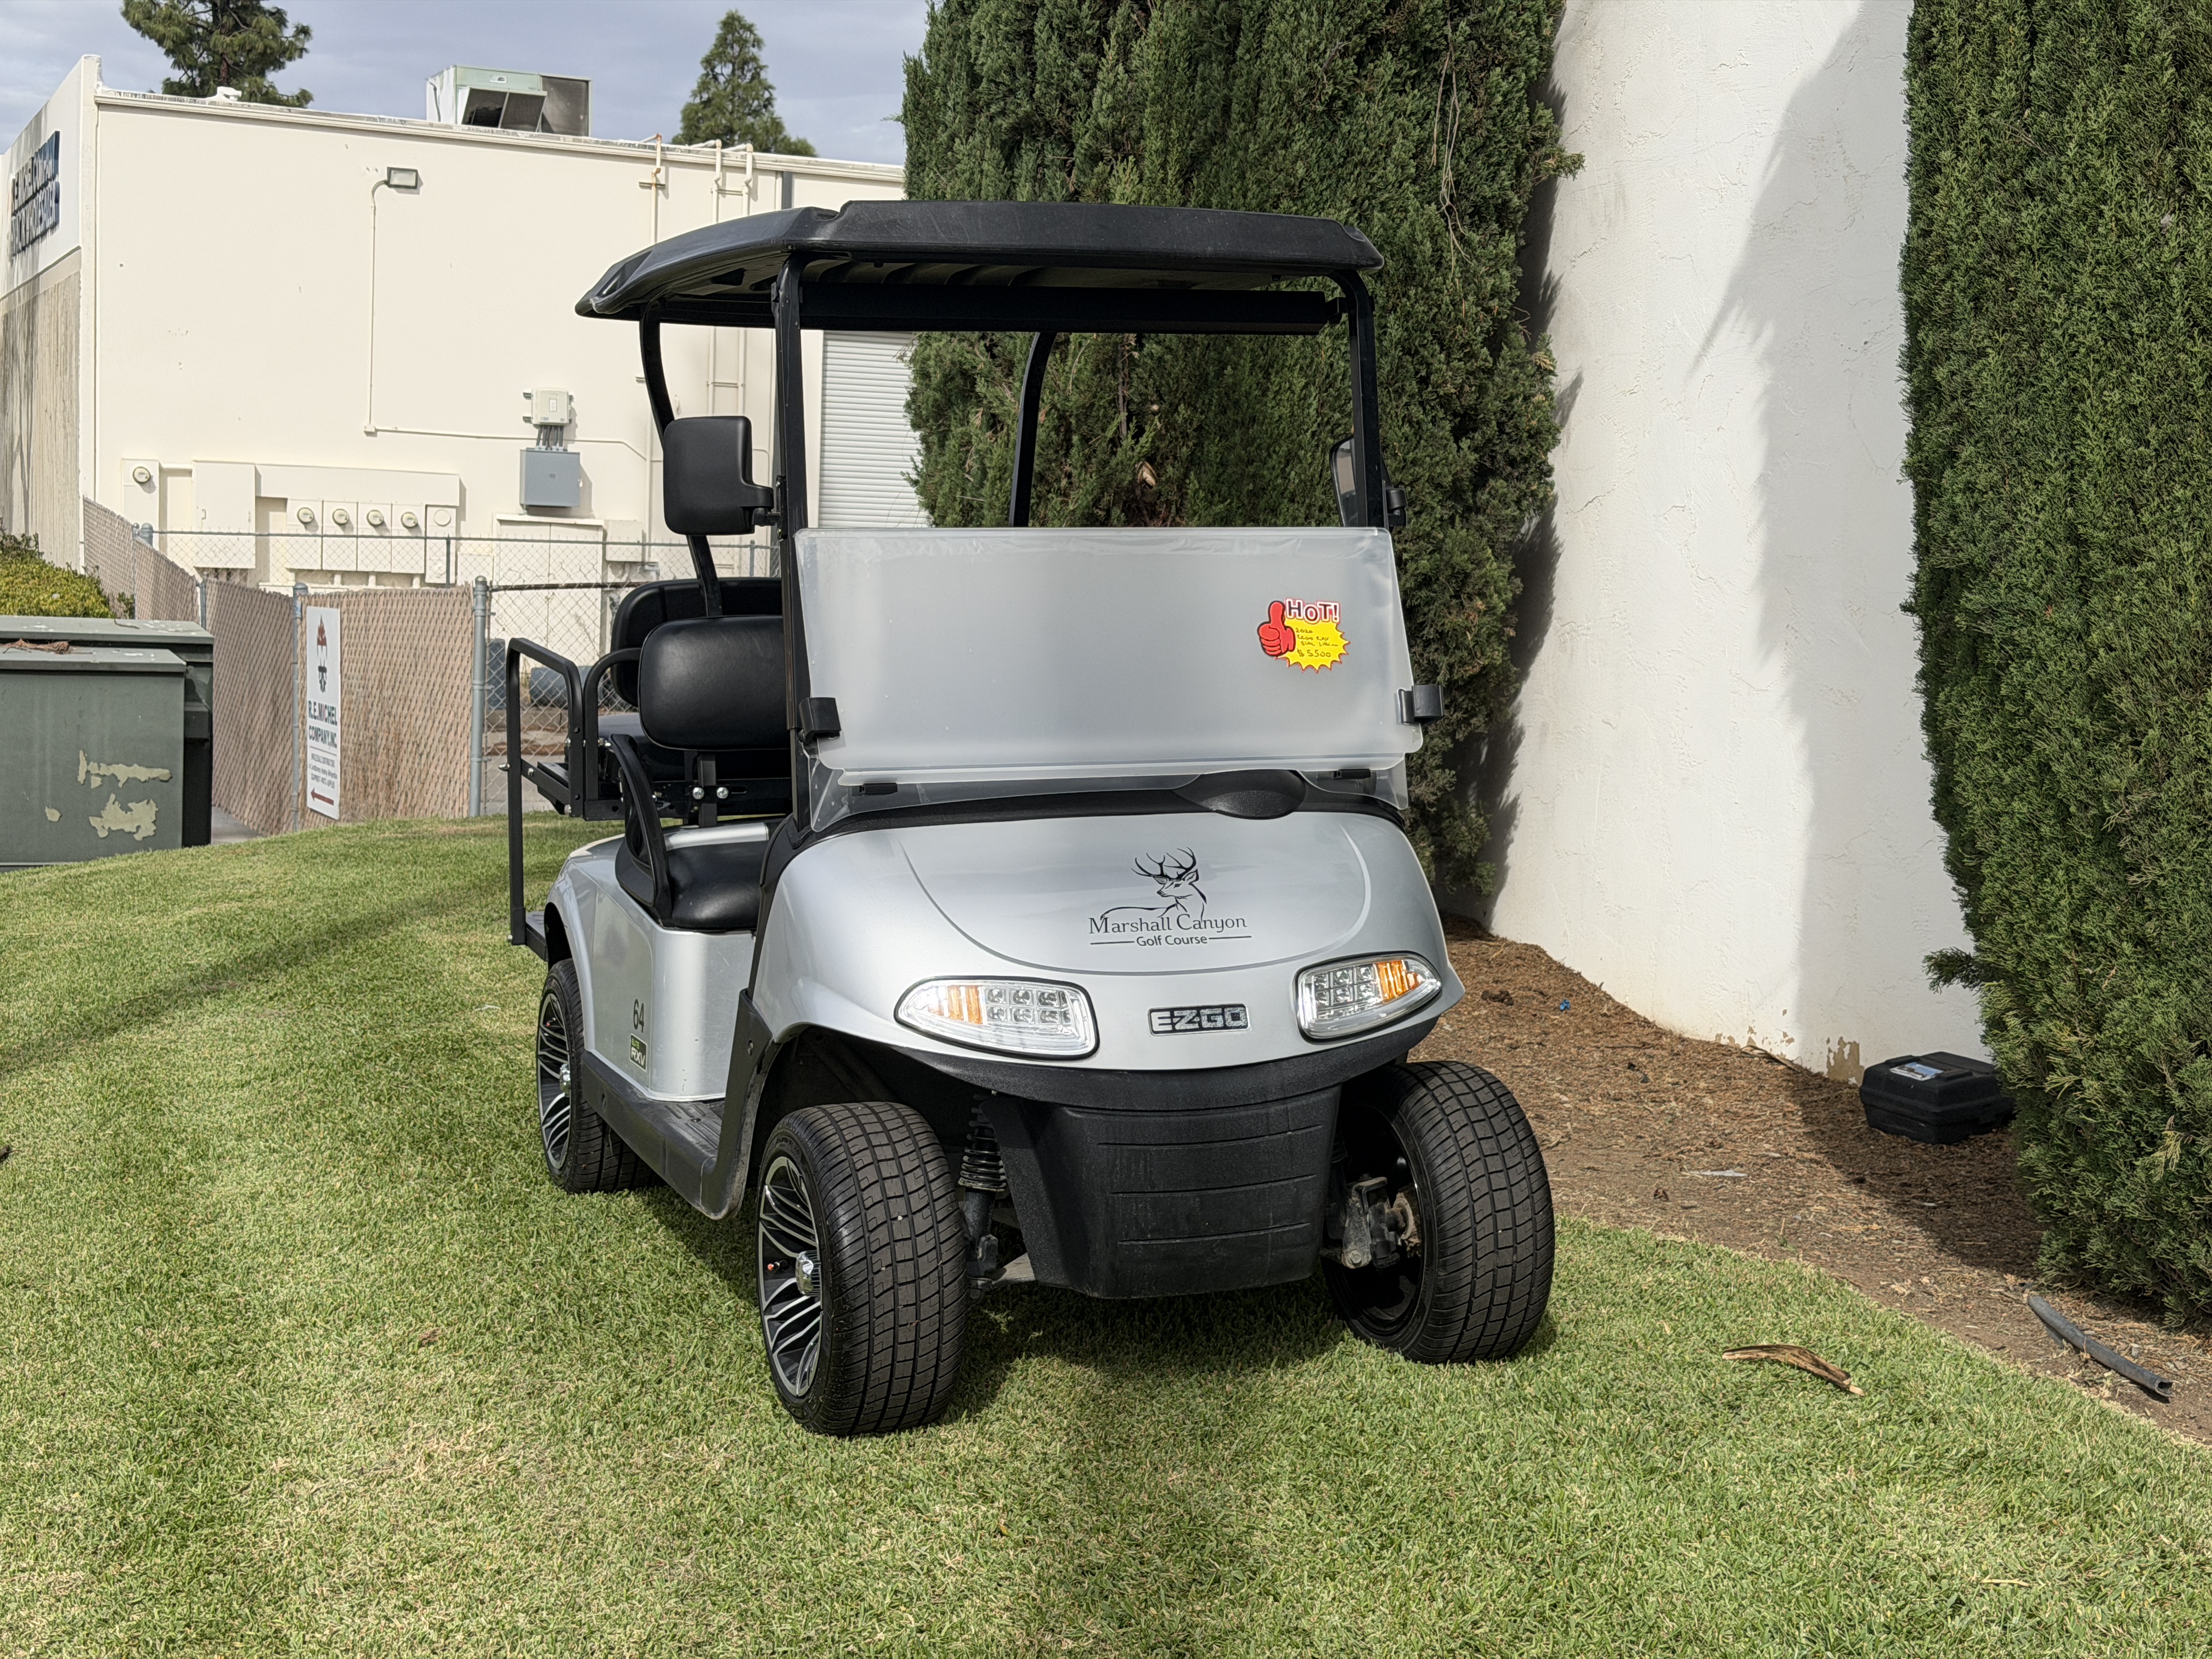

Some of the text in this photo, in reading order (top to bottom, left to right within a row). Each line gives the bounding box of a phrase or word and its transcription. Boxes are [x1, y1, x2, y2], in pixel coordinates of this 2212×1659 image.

[1286, 599, 1340, 624] HOT!
[1088, 914, 1248, 934] Marshall Canyon
[1136, 935, 1208, 946] Golf Course
[633, 998, 645, 1033] 64
[631, 1047, 645, 1066] RXV
